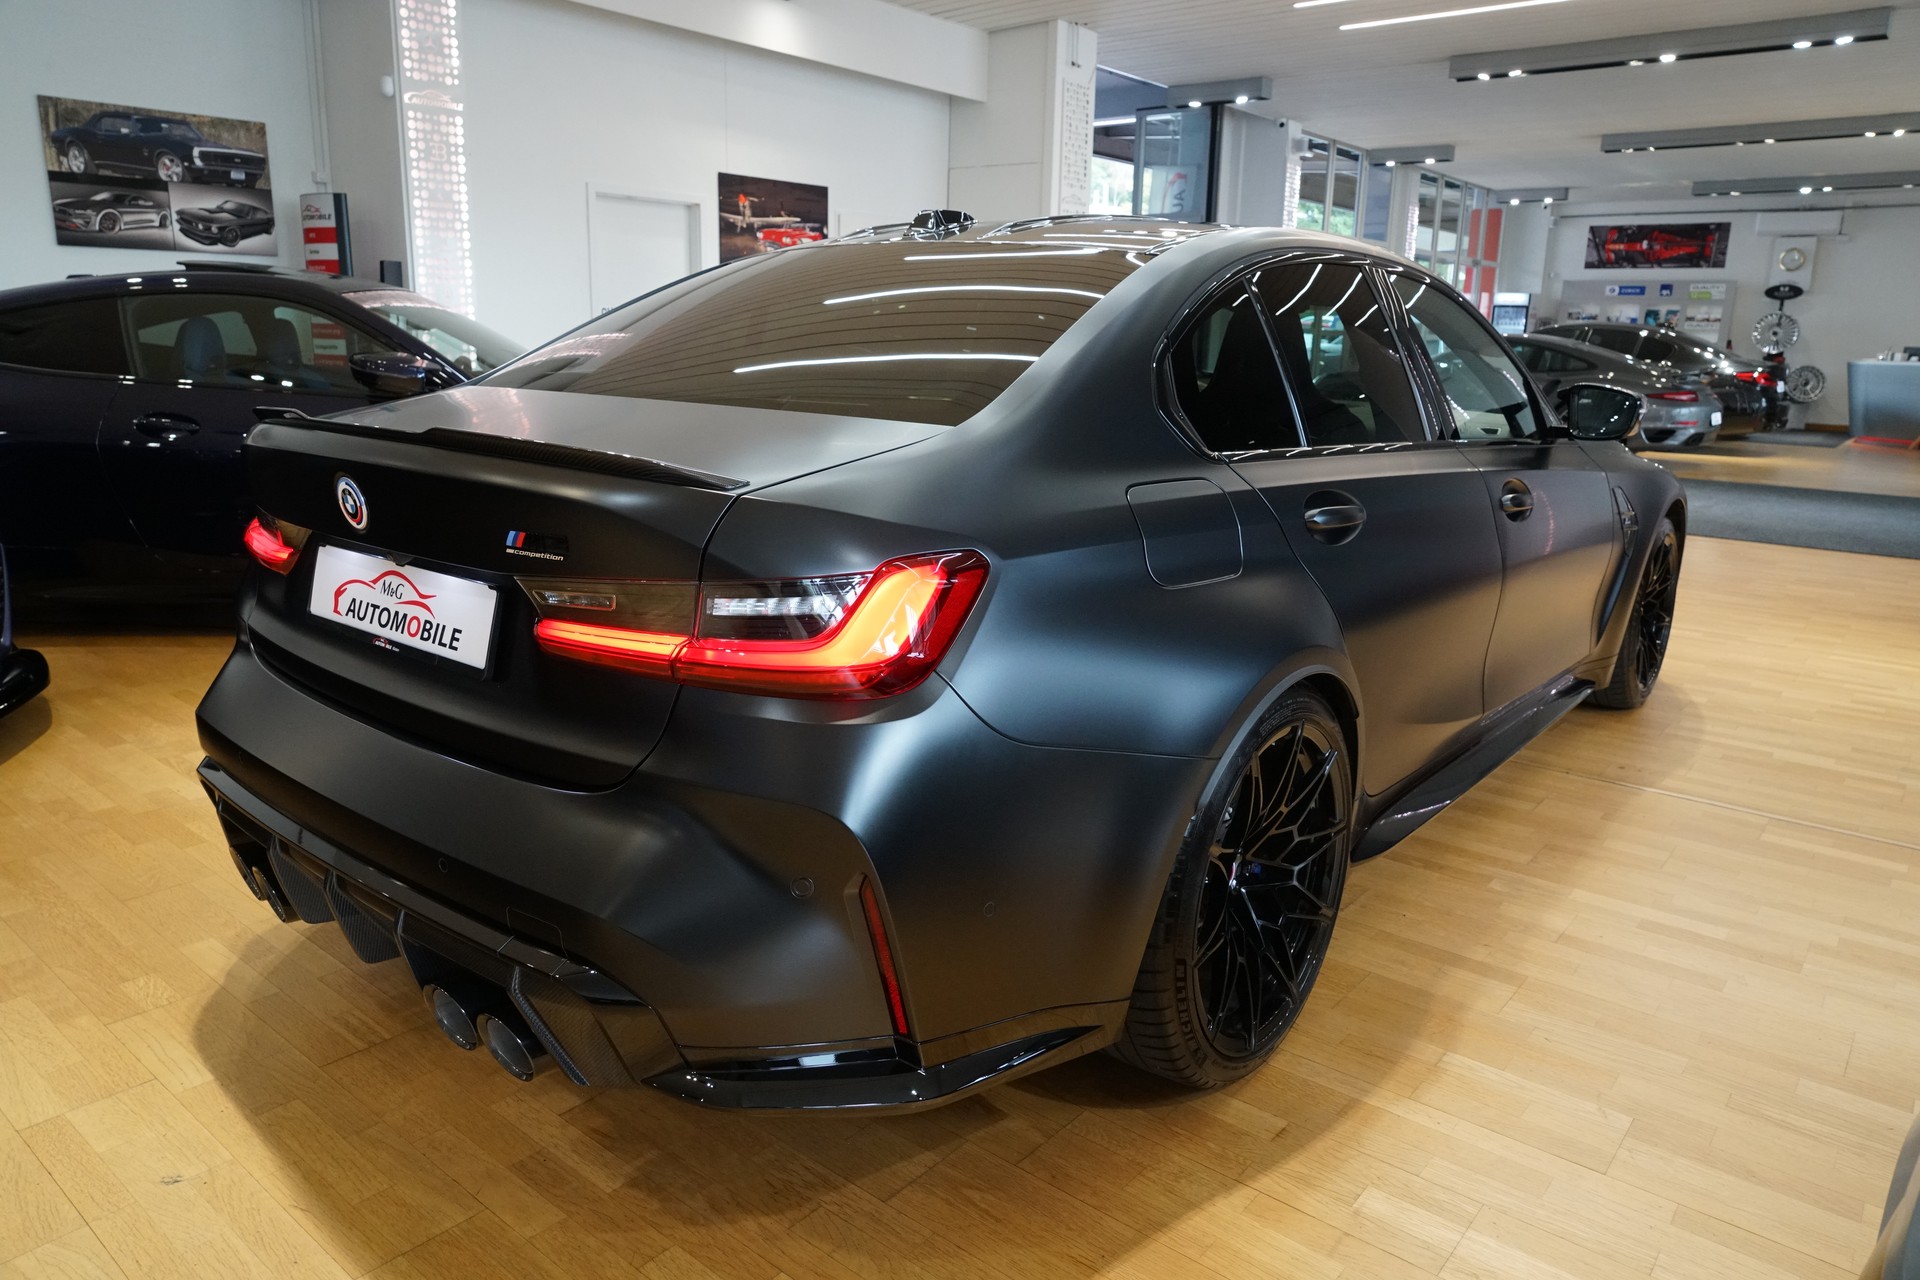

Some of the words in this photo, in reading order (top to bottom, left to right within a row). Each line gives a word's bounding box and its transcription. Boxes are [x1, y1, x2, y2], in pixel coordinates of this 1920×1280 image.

[411, 97, 463, 111] AUTOMOBILE
[514, 549, 564, 561] competition
[380, 579, 405, 600] M&G
[345, 597, 463, 652] AUTOMOBILE
